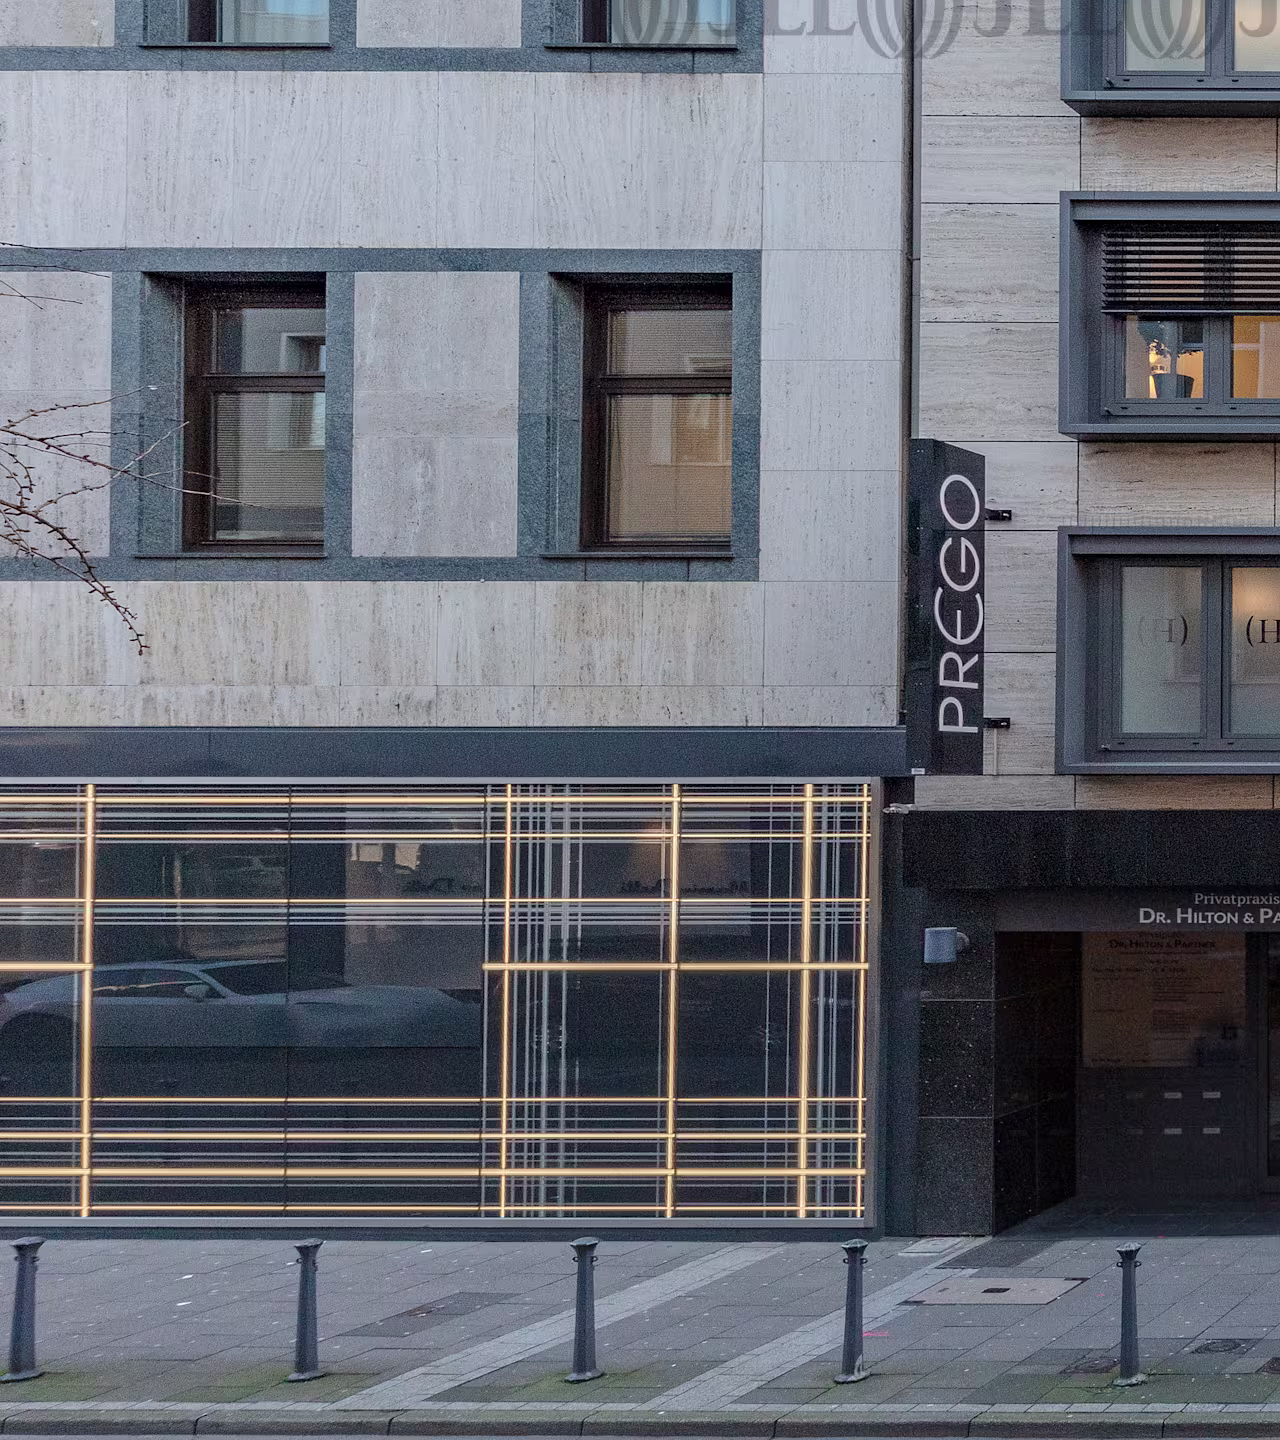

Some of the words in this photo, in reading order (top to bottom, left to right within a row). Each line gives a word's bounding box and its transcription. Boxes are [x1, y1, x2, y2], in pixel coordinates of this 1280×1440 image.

[934, 474, 984, 733] PREGO
[1194, 893, 1280, 907] Privatpraxis
[1243, 912, 1255, 924] &
